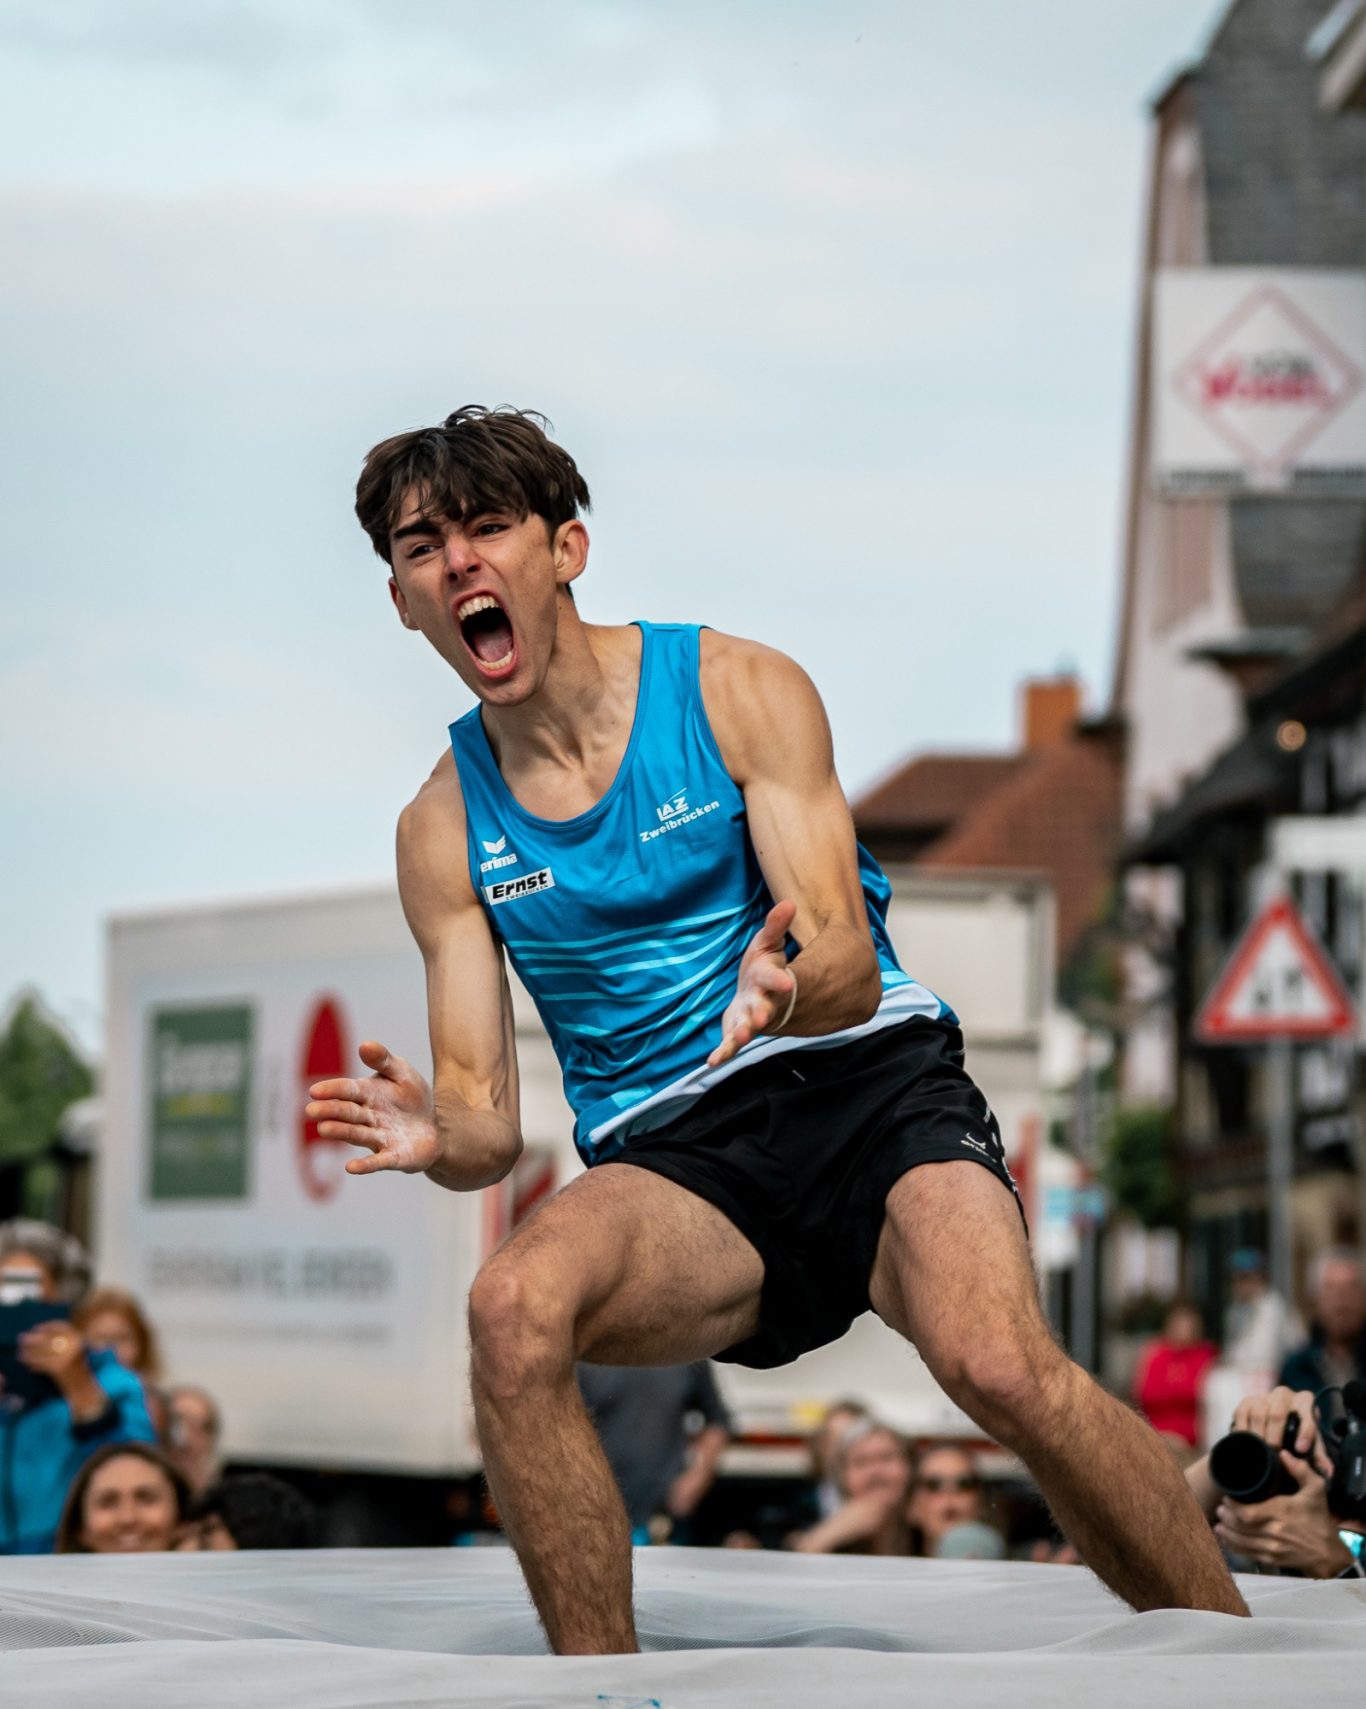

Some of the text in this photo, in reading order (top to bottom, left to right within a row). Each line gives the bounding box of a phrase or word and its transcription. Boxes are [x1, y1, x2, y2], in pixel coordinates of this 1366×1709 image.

[639, 800, 720, 843] Zweibrücken
[656, 796, 689, 822] LAZ
[480, 853, 518, 873] erima
[492, 871, 547, 899] Ernst
